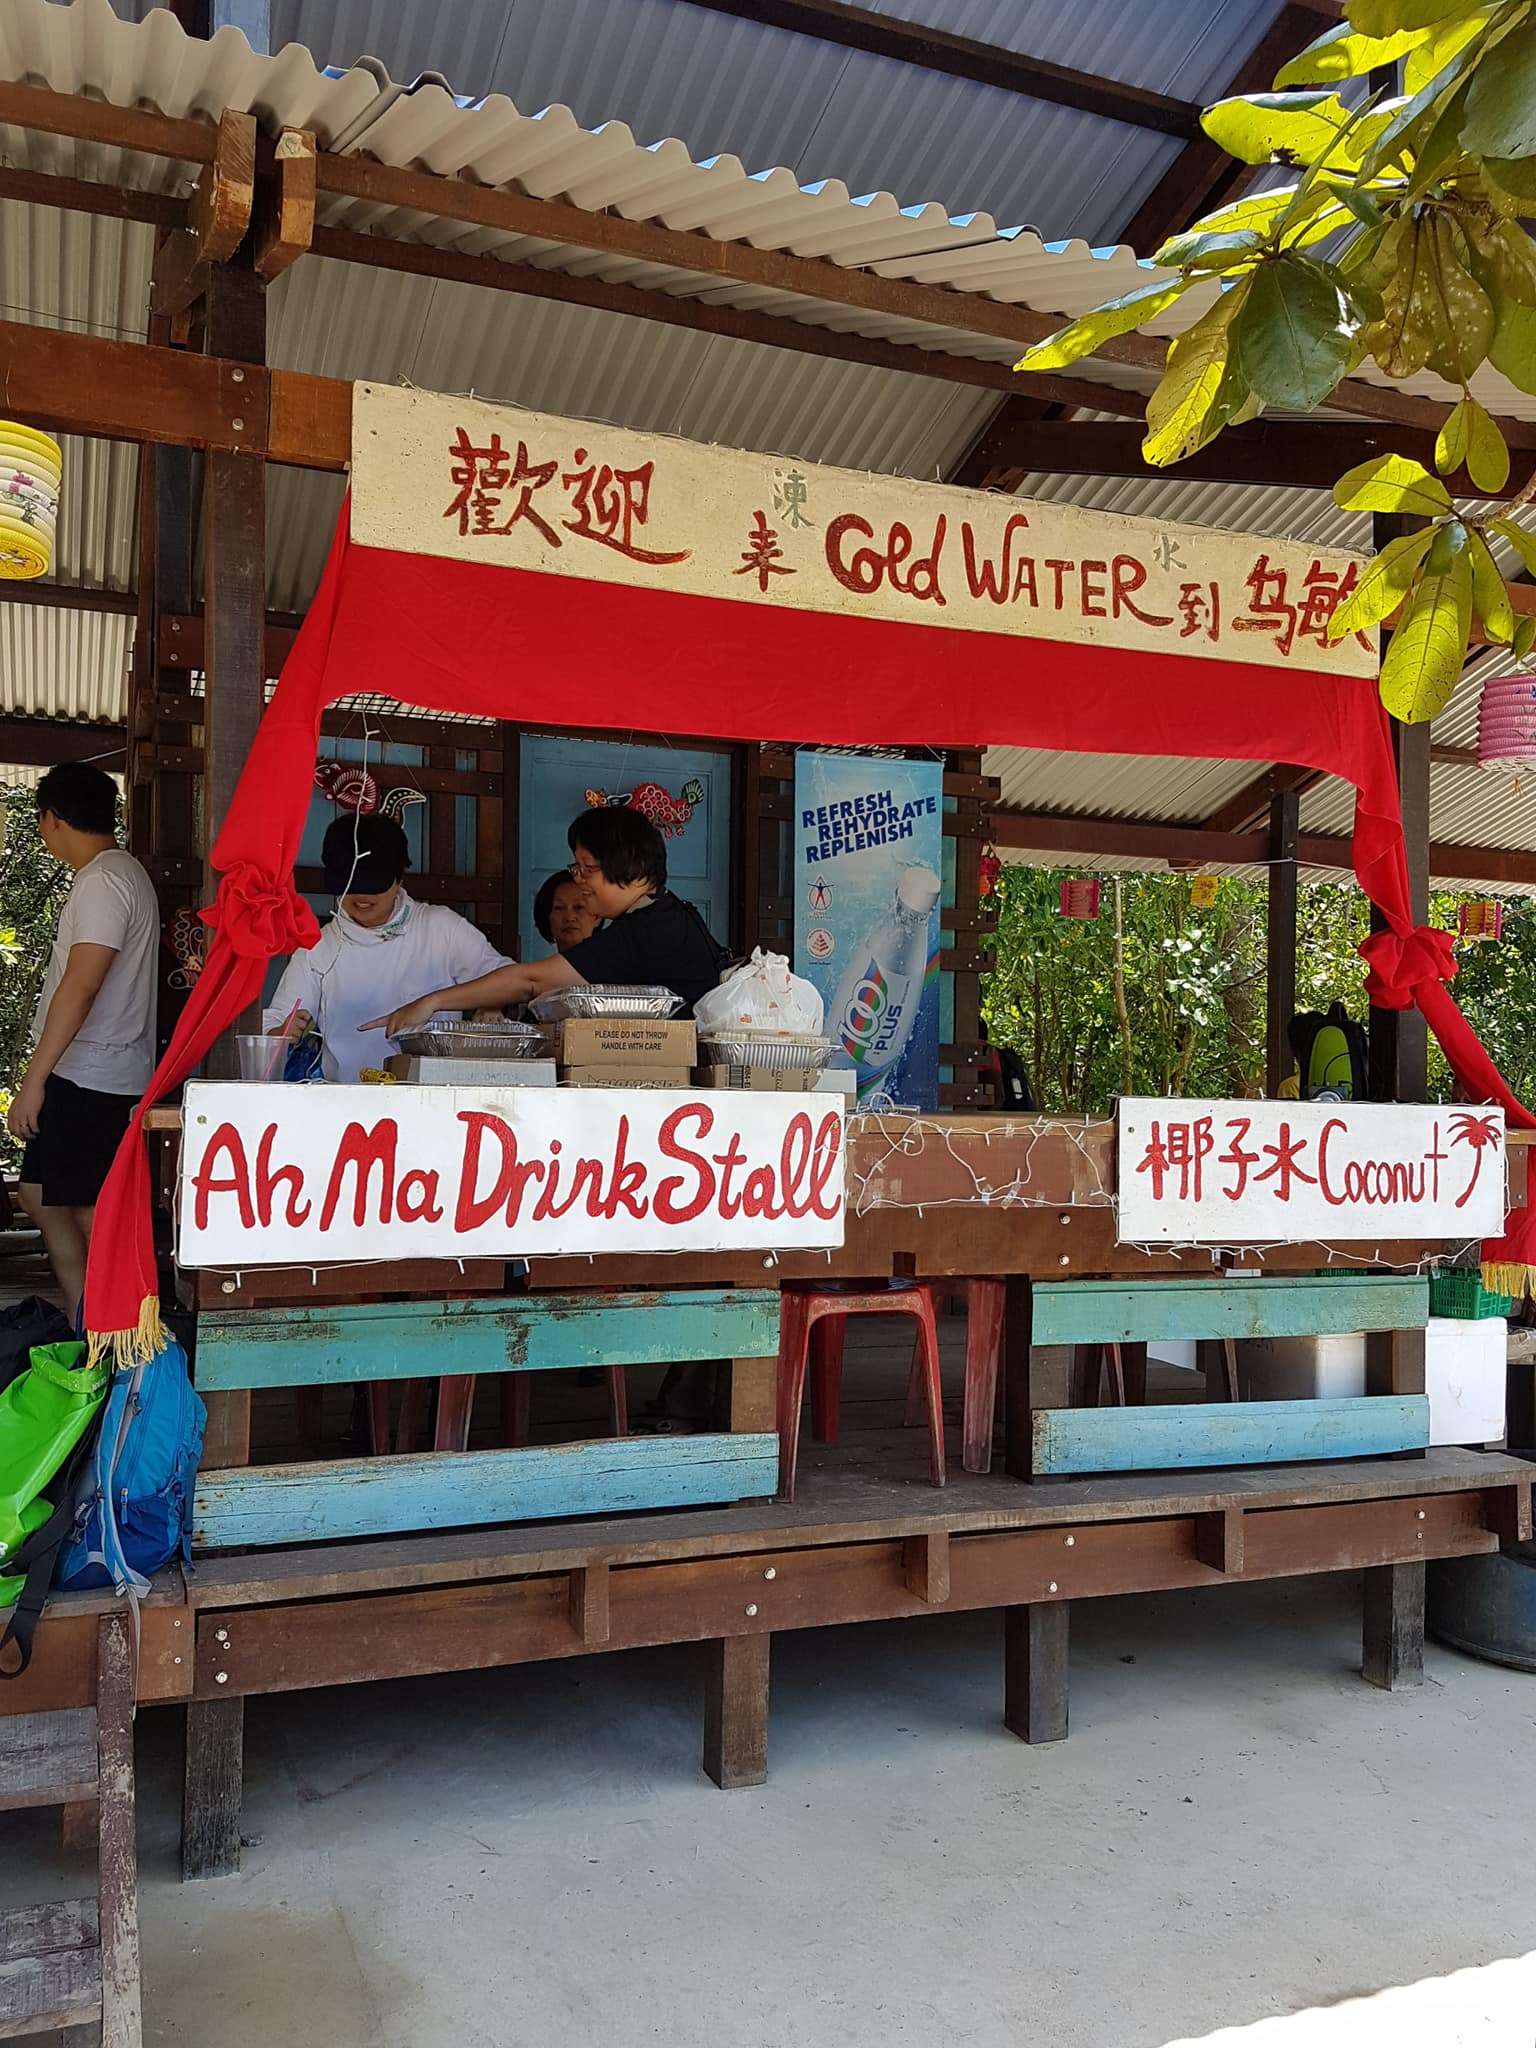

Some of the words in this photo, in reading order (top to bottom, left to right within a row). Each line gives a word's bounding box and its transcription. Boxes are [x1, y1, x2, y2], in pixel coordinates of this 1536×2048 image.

[443, 427, 690, 565] 歡迎
[824, 512, 948, 607] Cold
[1177, 581, 1220, 642] 到
[1153, 533, 1188, 572] 水
[802, 790, 892, 829] REFRESH
[818, 796, 937, 842] REHYDRATE
[805, 820, 914, 864] REPLENISH
[594, 1030, 620, 1040] PLEASE
[620, 1031, 631, 1039] DO
[631, 1031, 645, 1040] NOT
[645, 1031, 669, 1040] THROW
[837, 978, 888, 1050] 100
[873, 1004, 904, 1052] PLUS
[601, 1042, 627, 1050] HANDLE
[628, 1042, 644, 1050] WITH
[644, 1042, 663, 1051] CARE
[191, 1121, 312, 1231] Ah
[319, 1117, 444, 1233] Ma
[454, 1110, 650, 1234] Drink
[652, 1102, 843, 1226] Stall
[1136, 1115, 1318, 1202] 椰子水
[1317, 1118, 1449, 1206] Coconut
